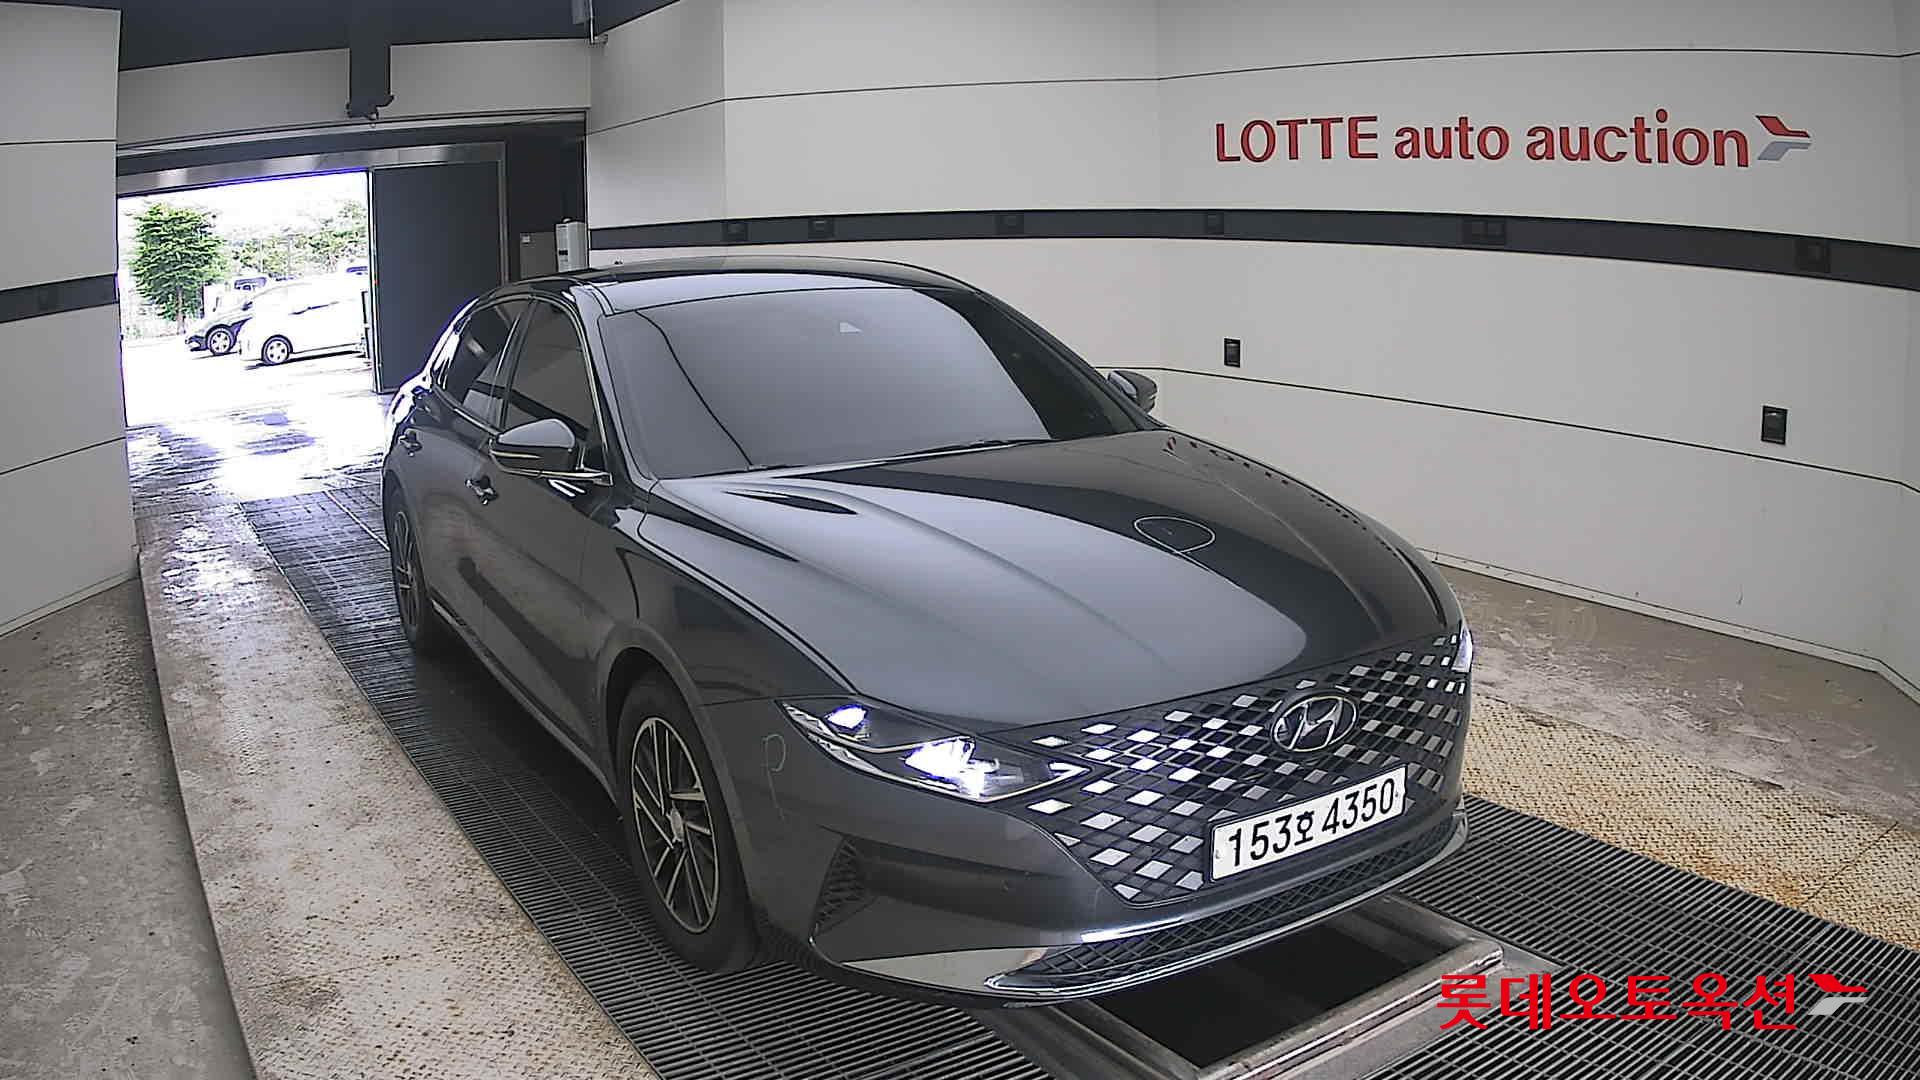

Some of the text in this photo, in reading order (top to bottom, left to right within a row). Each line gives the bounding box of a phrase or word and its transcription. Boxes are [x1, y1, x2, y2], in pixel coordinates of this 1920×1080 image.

[1215, 108, 1752, 168] LOTTE auto auction
[1228, 778, 1396, 867] 153호 4350
